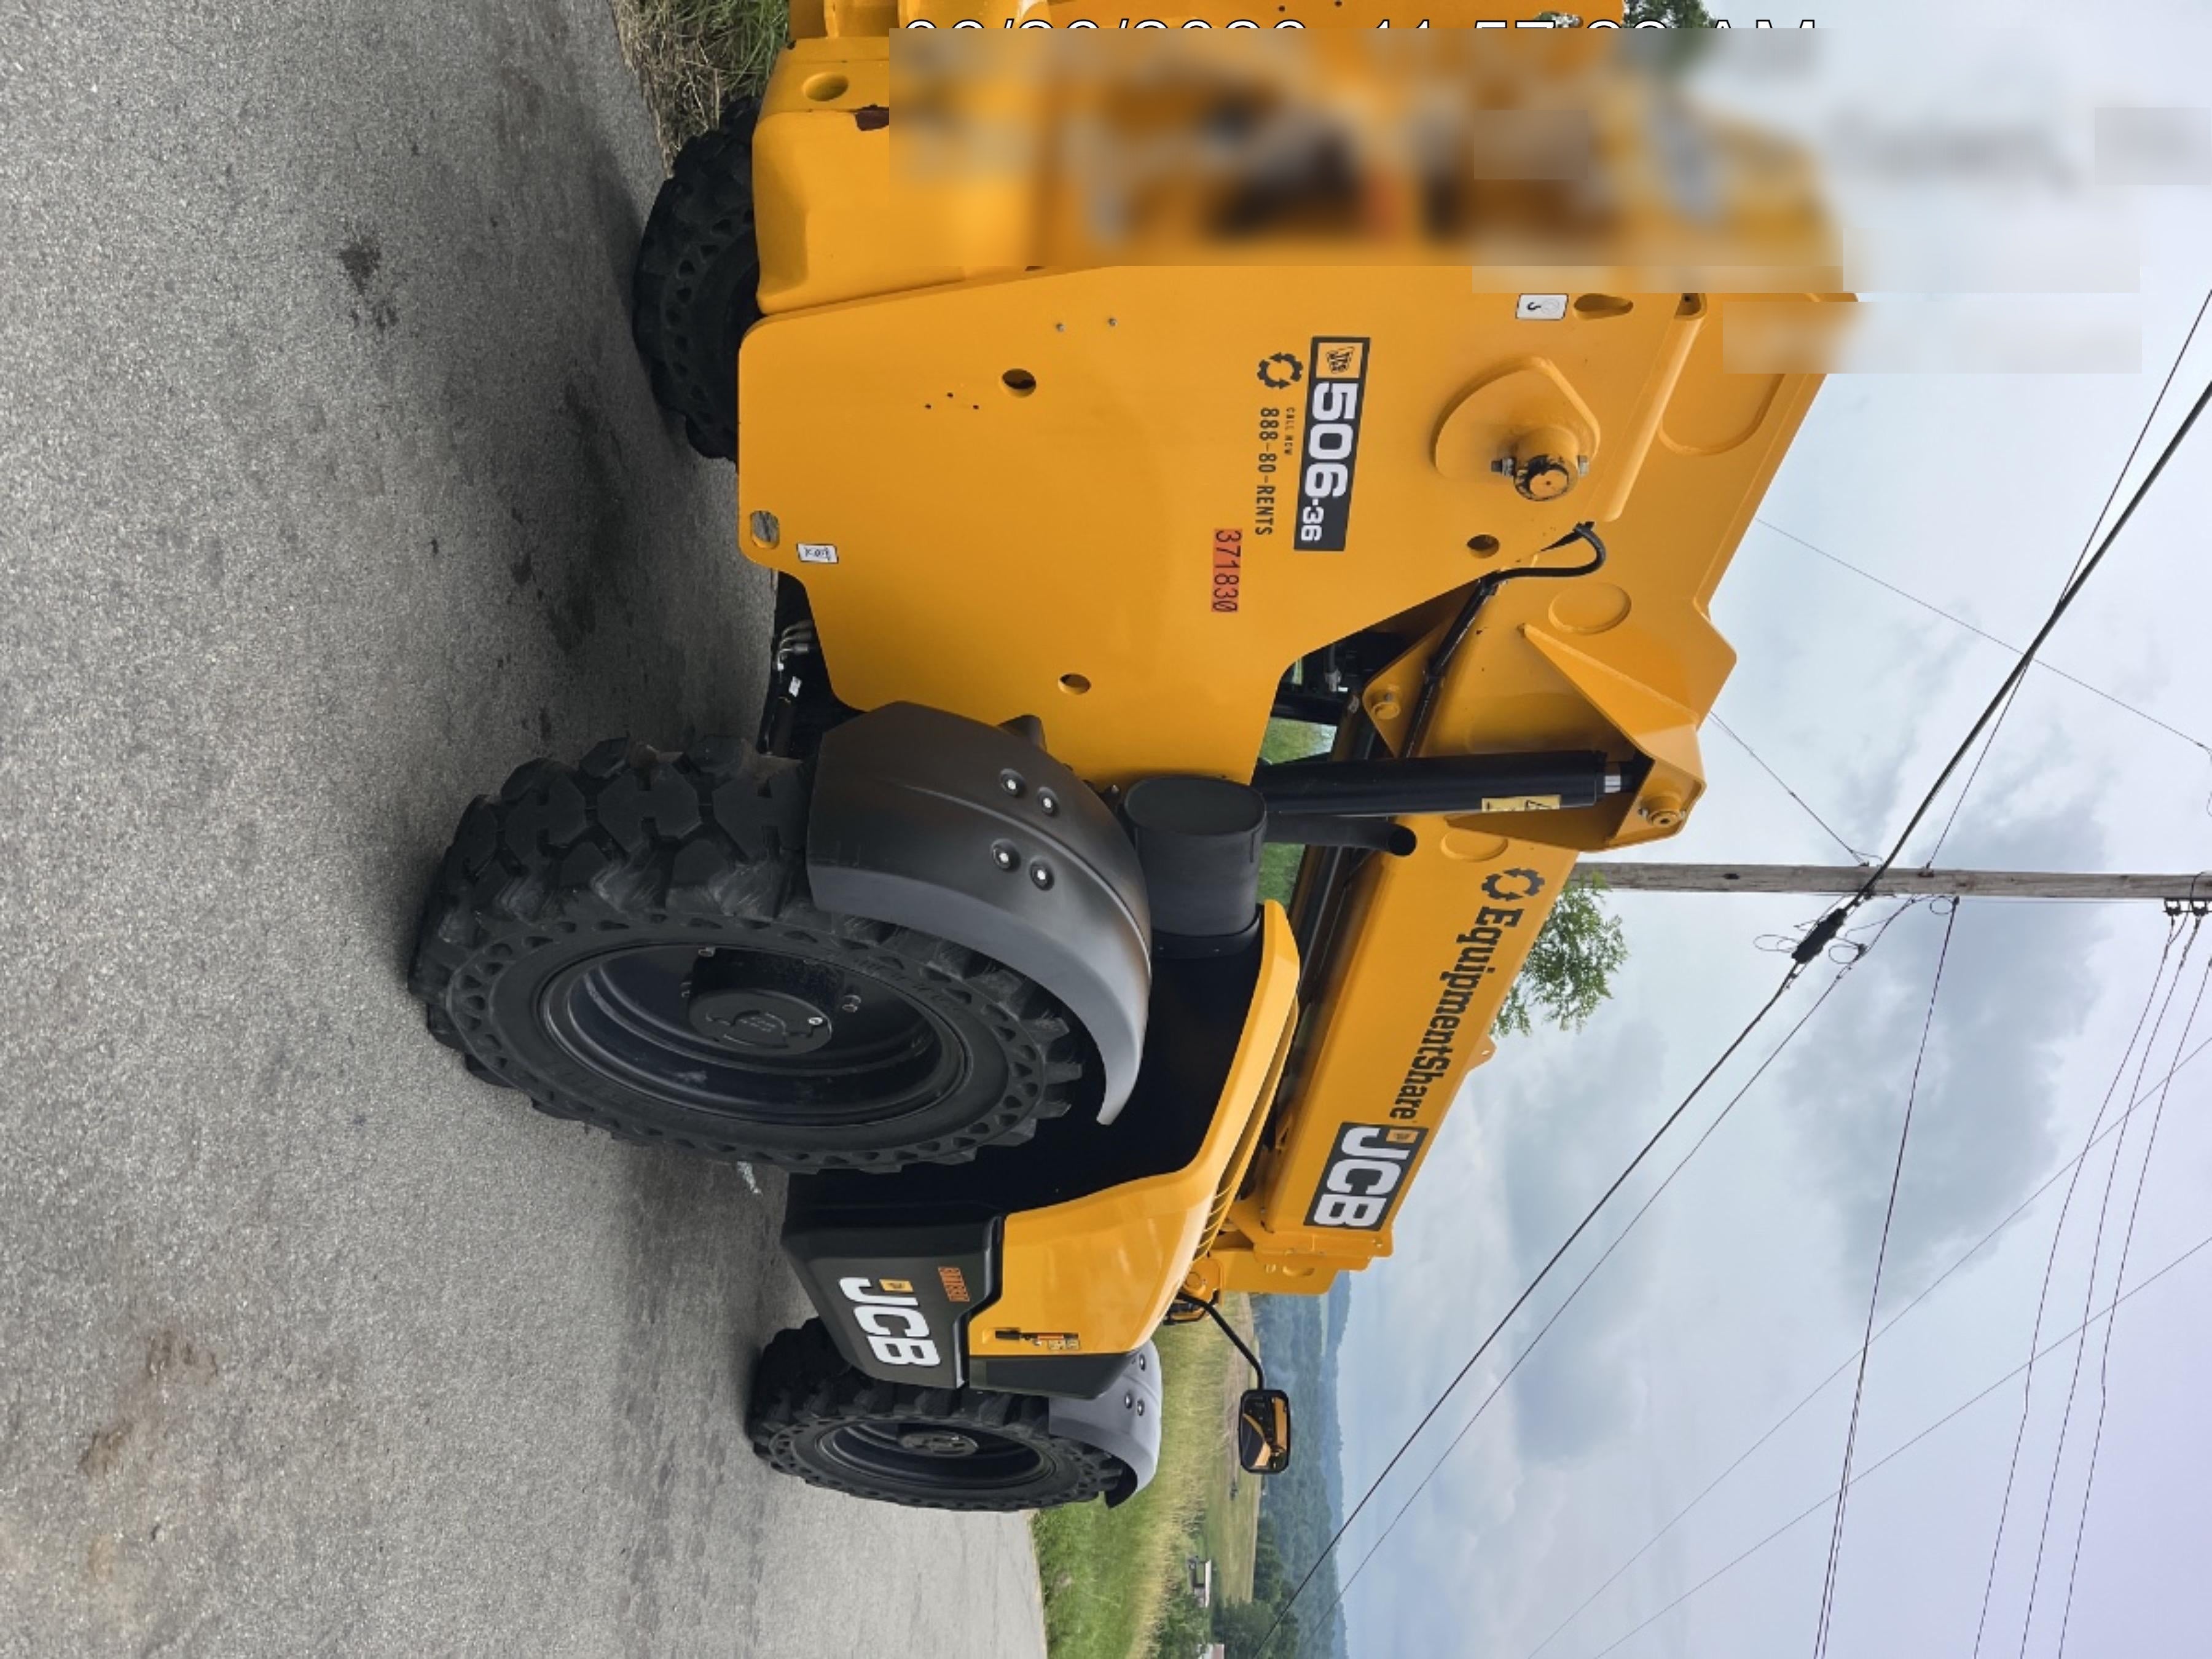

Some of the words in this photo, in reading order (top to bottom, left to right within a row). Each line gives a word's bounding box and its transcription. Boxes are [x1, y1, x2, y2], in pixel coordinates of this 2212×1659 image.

[1285, 407, 1295, 430] CALL
[1255, 407, 1279, 535] 888-80-RENTS
[1213, 530, 1242, 612] 371830
[1389, 906, 1524, 1120] EquipmentShare
[1314, 1127, 1411, 1227] JCB
[839, 1277, 941, 1367] JCB
